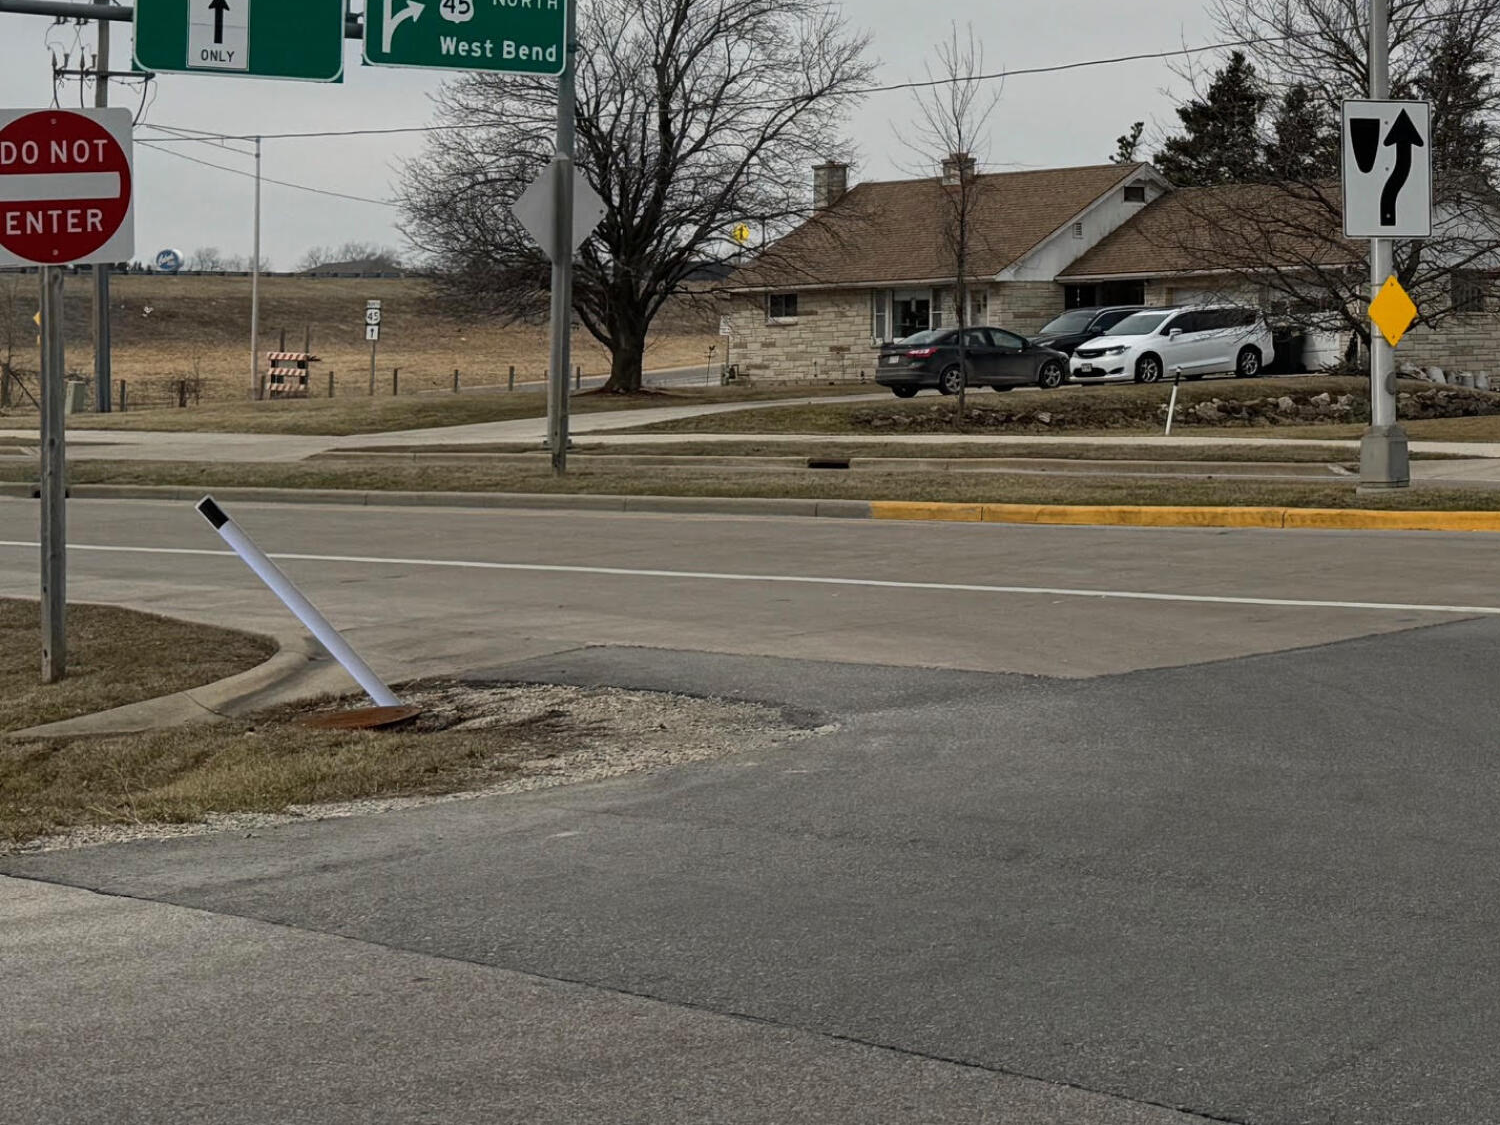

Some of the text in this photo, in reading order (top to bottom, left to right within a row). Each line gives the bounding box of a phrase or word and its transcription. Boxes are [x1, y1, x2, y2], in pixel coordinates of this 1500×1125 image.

[201, 49, 235, 62] ONLY
[440, 36, 557, 62] West Bend
[0, 139, 108, 164] DO NOT
[6, 208, 103, 235] ENTER
